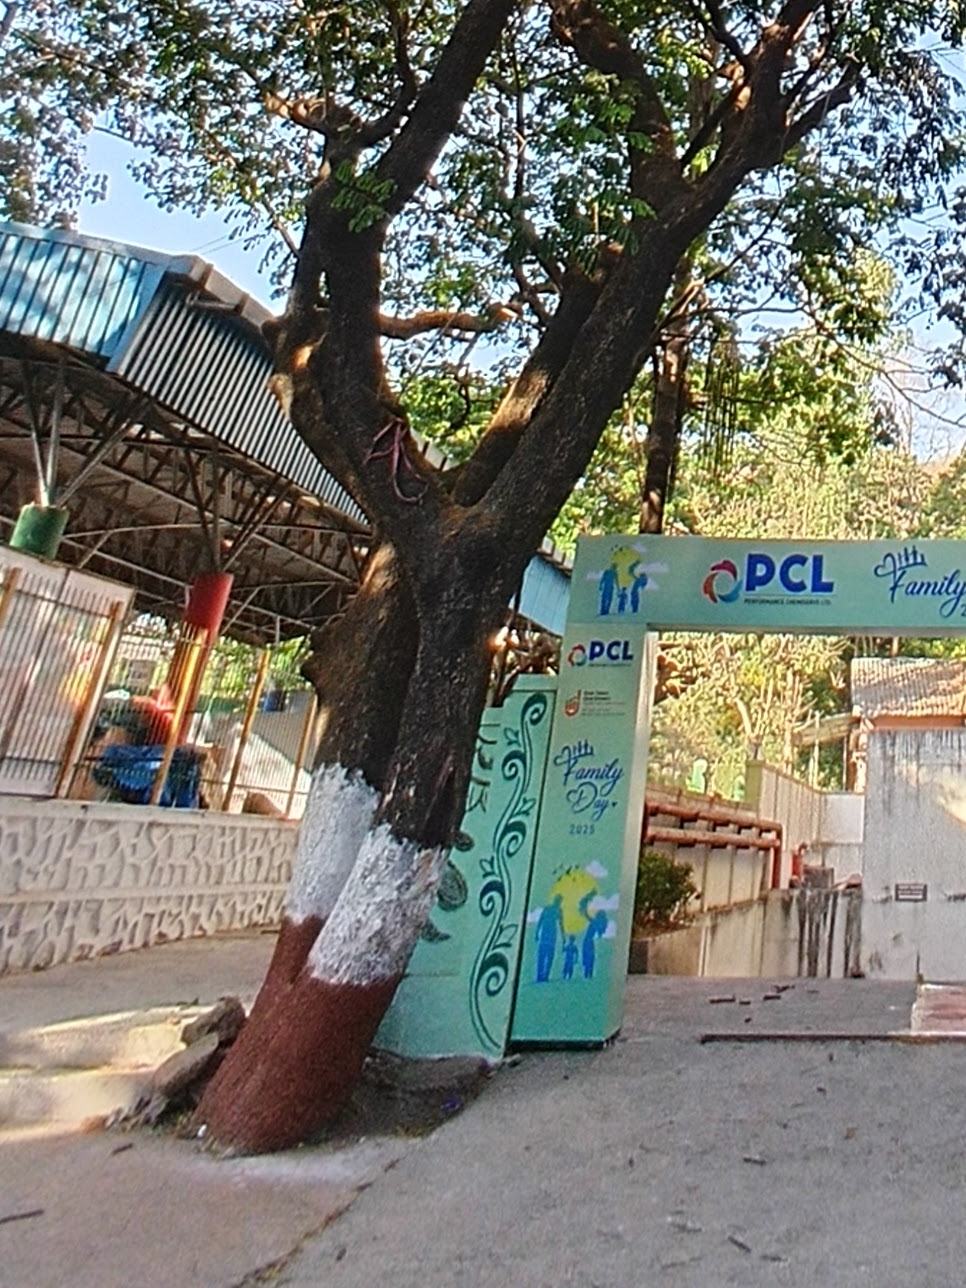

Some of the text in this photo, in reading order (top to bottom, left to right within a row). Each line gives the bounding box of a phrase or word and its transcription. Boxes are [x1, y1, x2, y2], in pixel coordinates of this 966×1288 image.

[745, 553, 835, 593] PCL
[588, 639, 634, 661] PCL
[553, 738, 624, 797] Family
[566, 781, 610, 822] Day
[569, 823, 596, 835] 2025
